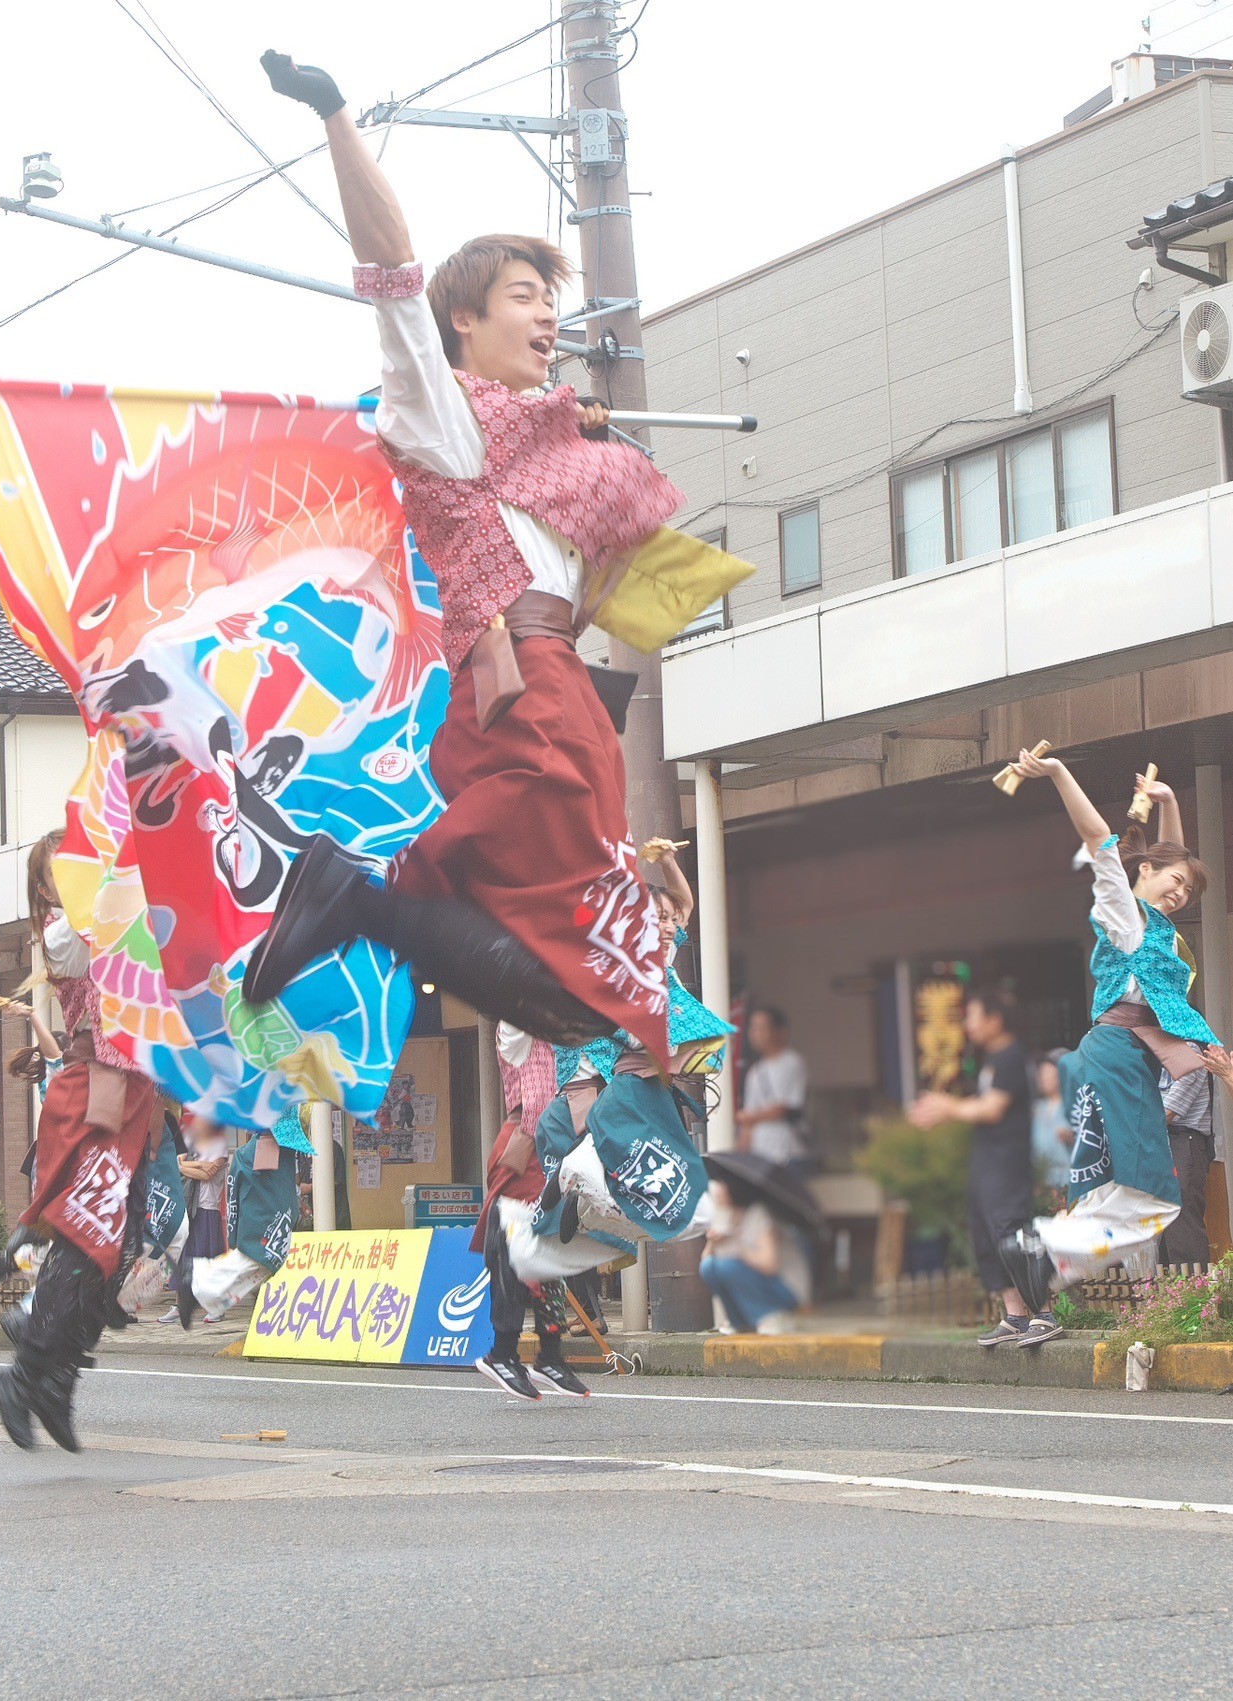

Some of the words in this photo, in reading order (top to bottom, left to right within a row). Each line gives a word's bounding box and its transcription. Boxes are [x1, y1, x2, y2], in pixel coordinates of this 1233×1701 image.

[421, 1190, 471, 1200] 明るい店内
[427, 1336, 470, 1357] UEKI
